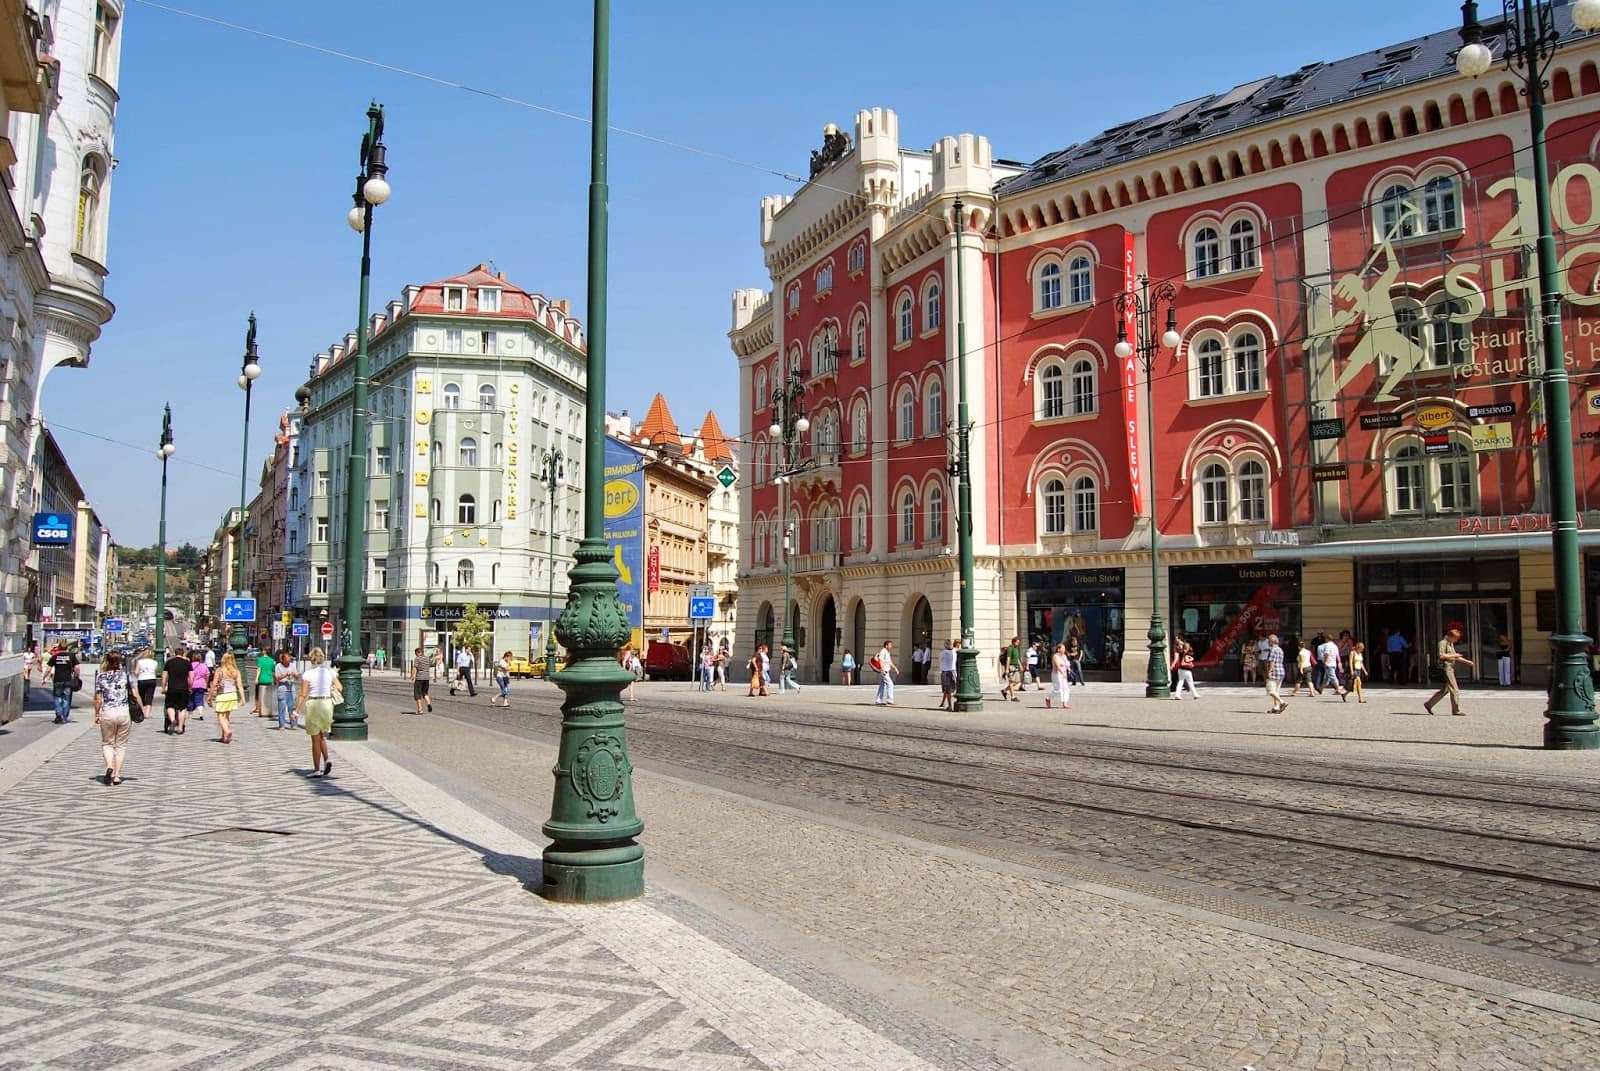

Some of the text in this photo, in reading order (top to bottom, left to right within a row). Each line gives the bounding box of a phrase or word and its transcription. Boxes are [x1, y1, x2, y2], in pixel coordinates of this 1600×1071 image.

[1126, 250, 1139, 496] SLEVY SALE SLEVY
[1477, 405, 1512, 415] RESERVED
[1419, 411, 1451, 422] albert
[1474, 436, 1512, 446] SPARKYS
[416, 378, 432, 518] HOTEL
[508, 384, 519, 520] CITY CENTRE
[604, 463, 640, 477] ERMARKET
[606, 490, 632, 505] bert
[1458, 512, 1584, 532] PALLADI
[37, 528, 68, 538] ČSOB
[1074, 574, 1120, 583] Urban Store
[1240, 568, 1295, 578] Urban Store
[435, 606, 460, 617] ČESKÁ
